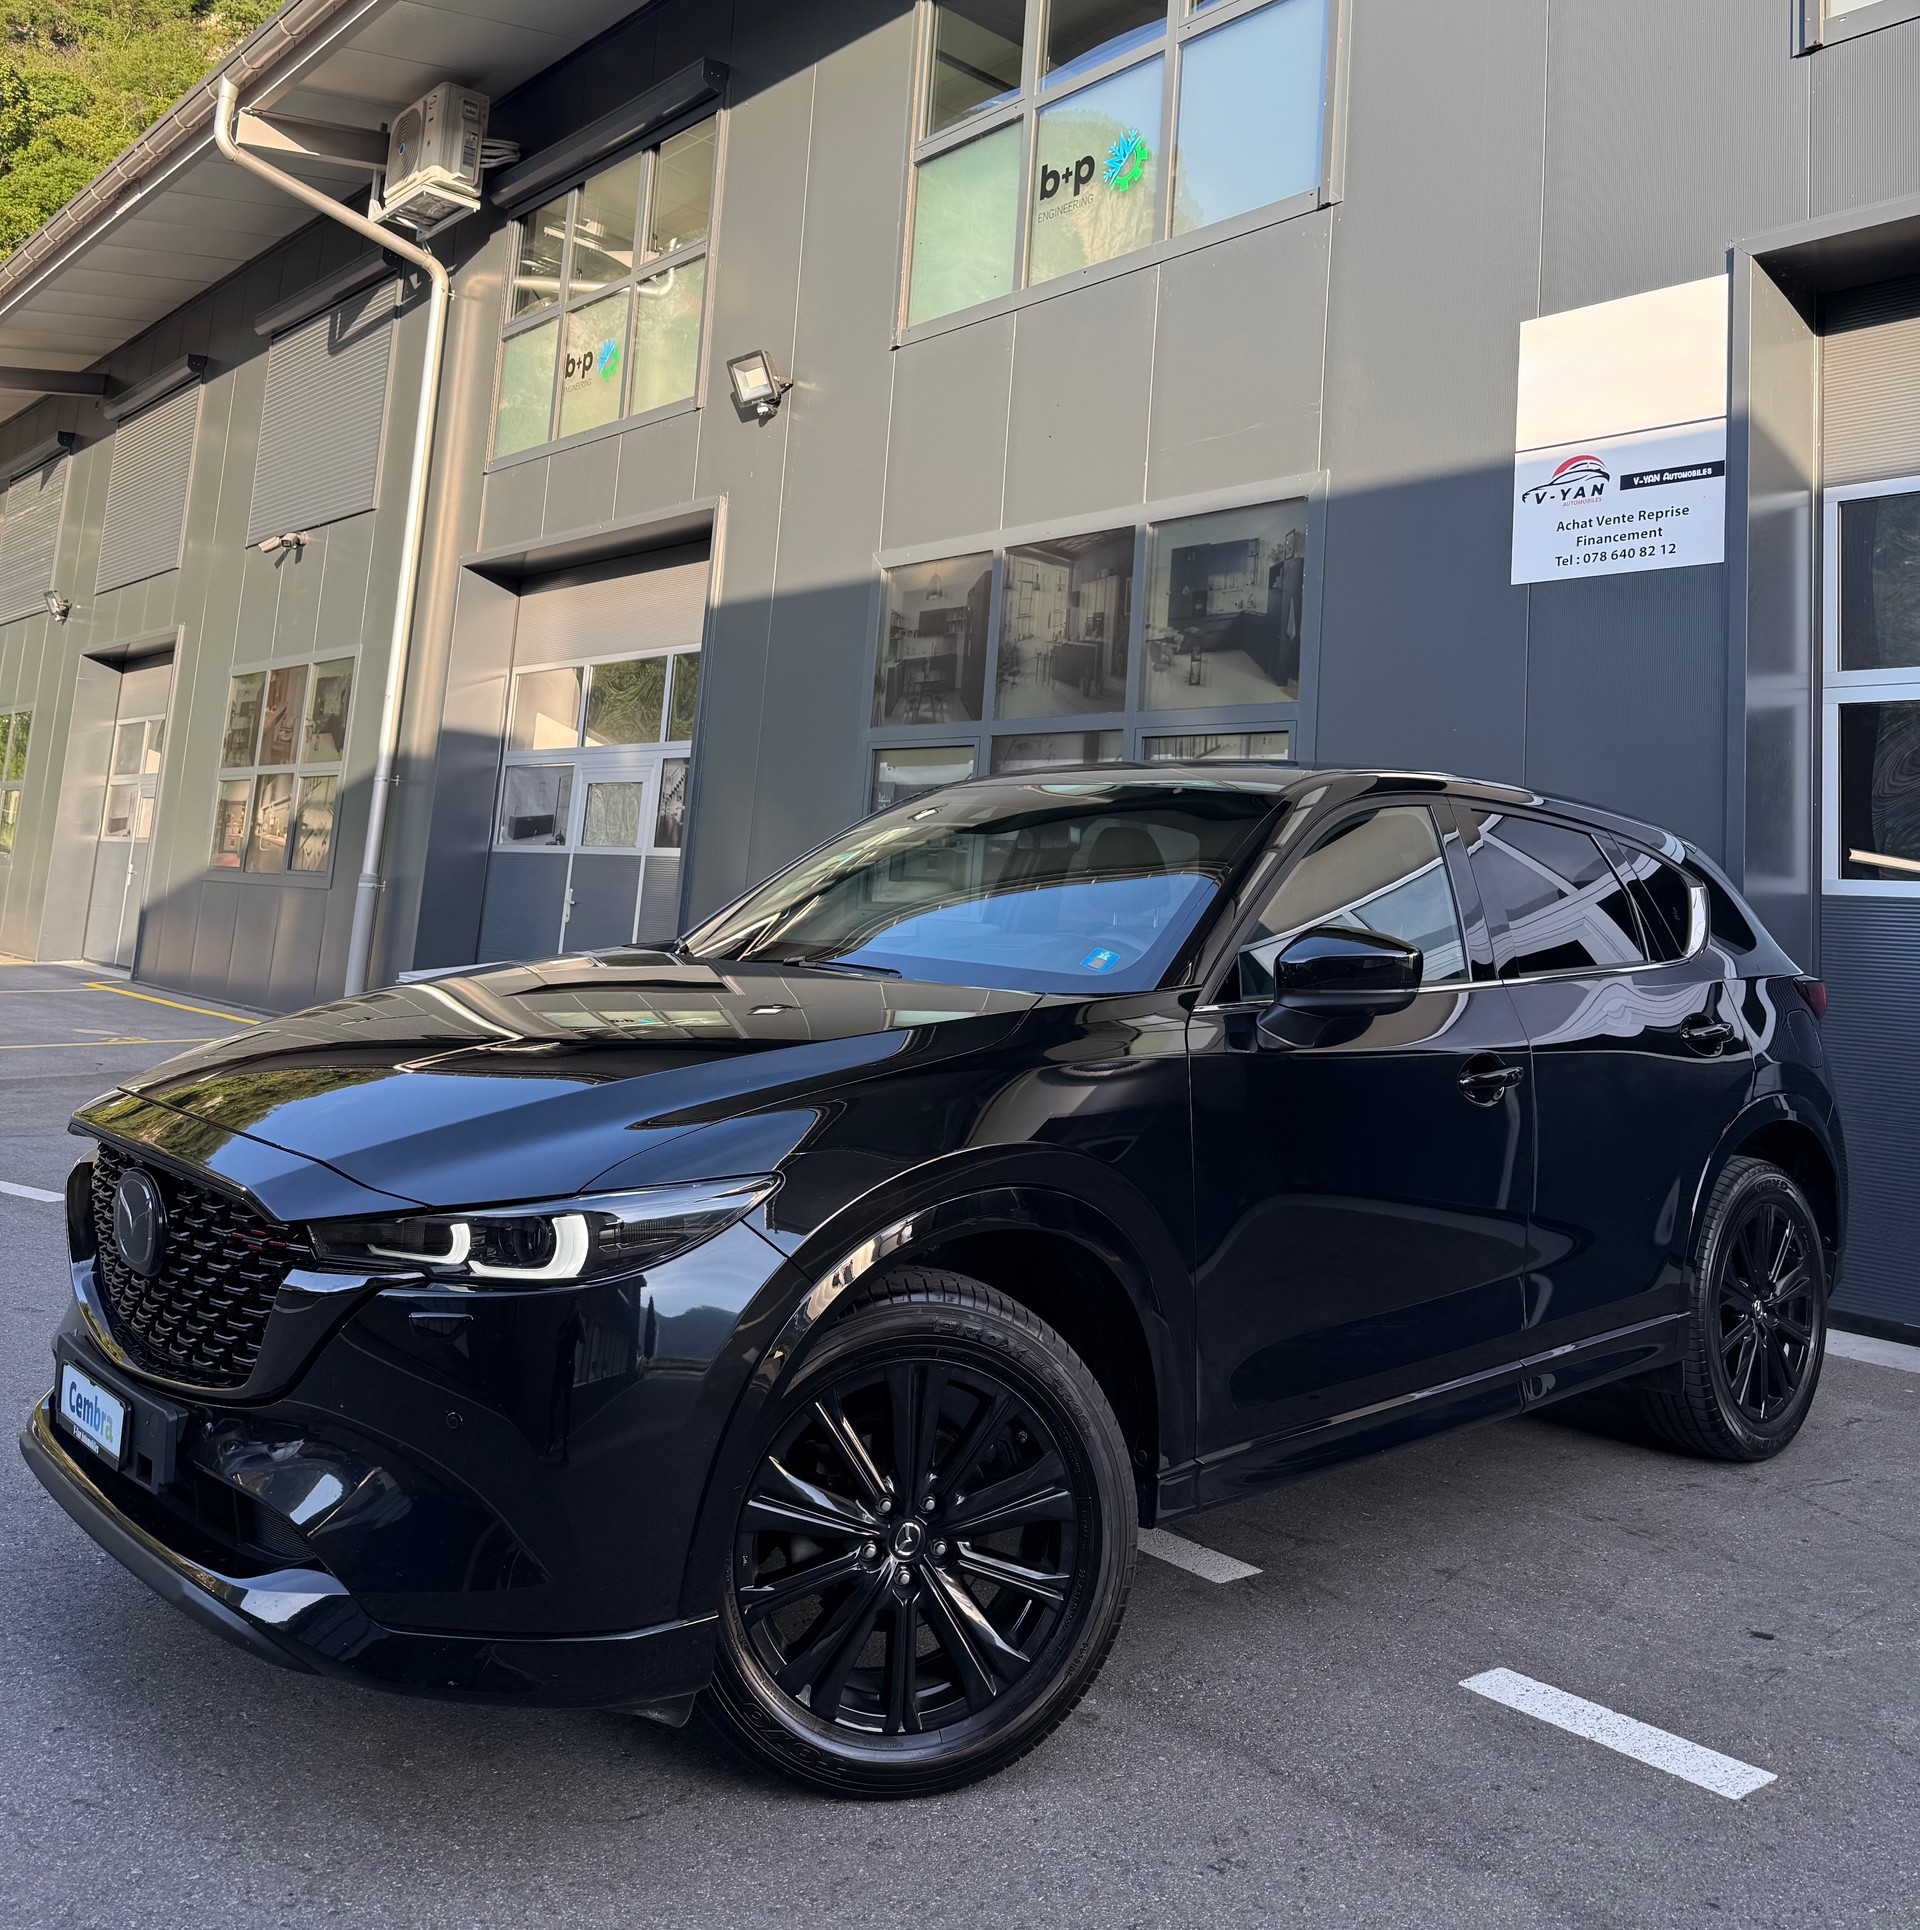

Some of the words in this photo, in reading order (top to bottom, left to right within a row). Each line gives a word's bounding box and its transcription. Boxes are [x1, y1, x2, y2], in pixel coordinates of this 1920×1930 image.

[1040, 155, 1096, 201] b+p
[1037, 193, 1094, 223] ENGINEERING
[565, 351, 593, 379] b+p
[1633, 473, 1661, 486] V-YAN
[1535, 483, 1605, 505] V-YAN
[1562, 497, 1602, 507] AUTOMOBILES
[1556, 518, 1593, 532] Achat
[1596, 513, 1635, 526] Vente
[1638, 506, 1690, 521] Reprise
[1576, 527, 1663, 547] Financement
[1583, 551, 1608, 564] 078
[1610, 547, 1636, 560] 640
[1639, 545, 1656, 557] 82
[1661, 543, 1677, 555] 12
[932, 1318, 1061, 1386] PROXES
[69, 1381, 113, 1444] Cembra
